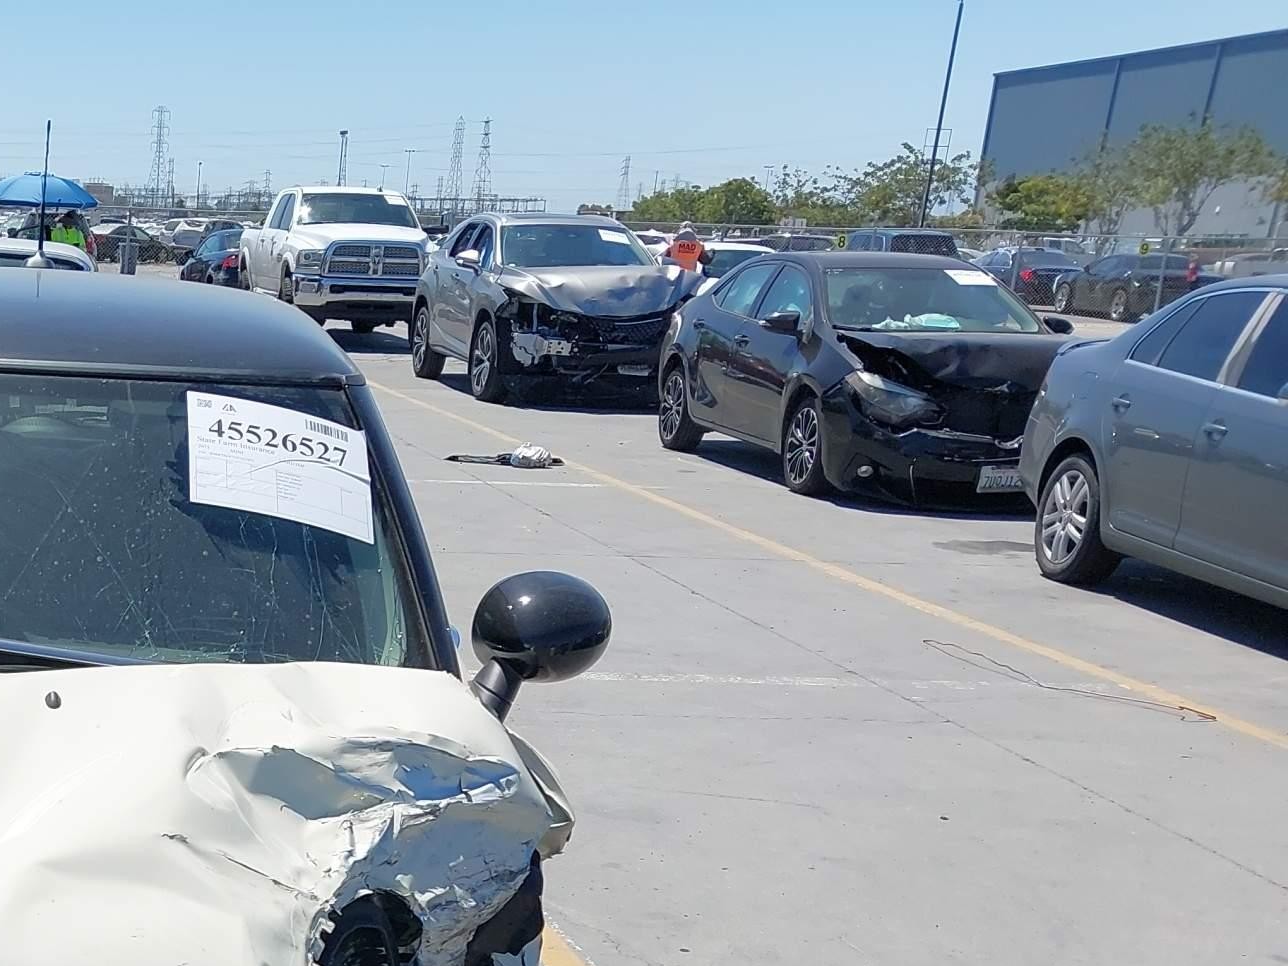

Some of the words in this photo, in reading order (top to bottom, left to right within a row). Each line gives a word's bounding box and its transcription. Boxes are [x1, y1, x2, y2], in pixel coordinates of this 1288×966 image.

[678, 243, 697, 251] MAD
[837, 235, 846, 249] 8
[1140, 243, 1149, 256] 9
[208, 418, 348, 466] 45526527
